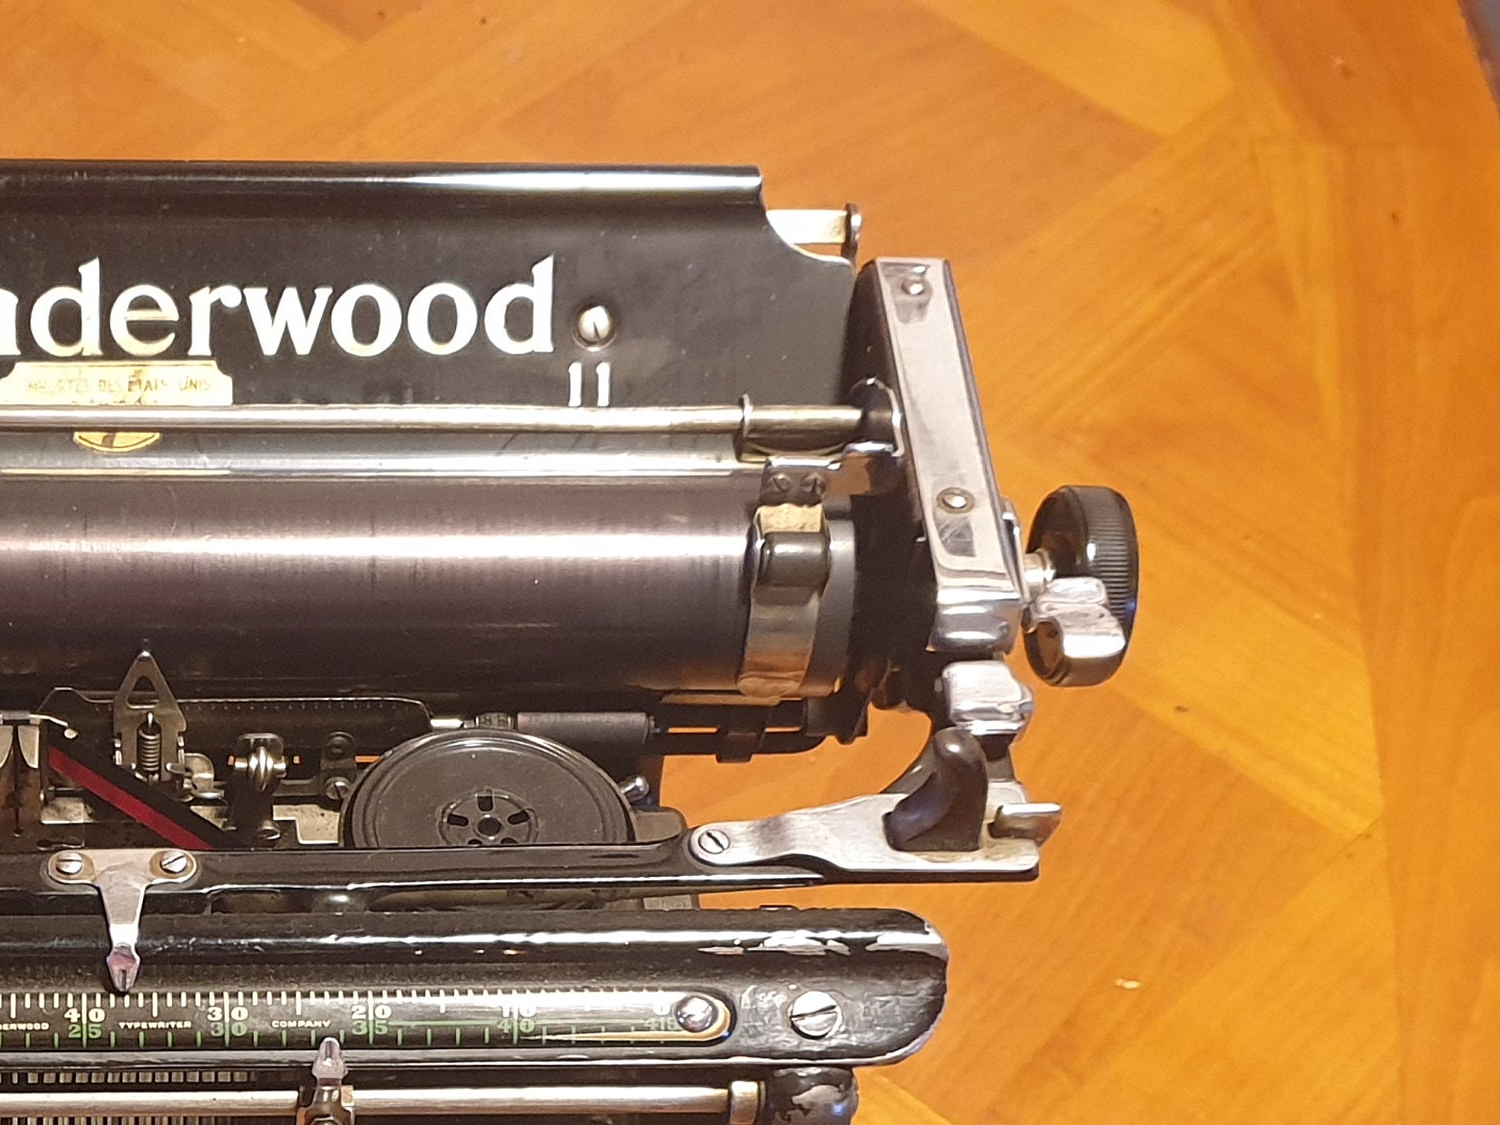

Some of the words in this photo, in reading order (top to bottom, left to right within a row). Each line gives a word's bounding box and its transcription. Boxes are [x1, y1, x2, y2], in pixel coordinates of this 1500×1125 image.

[65, 1011, 106, 1024] 40
[207, 1009, 249, 1023] 30
[351, 1006, 392, 1020] 20
[117, 1019, 193, 1030] TYPEWRITER
[270, 1018, 332, 1029] COMPANY
